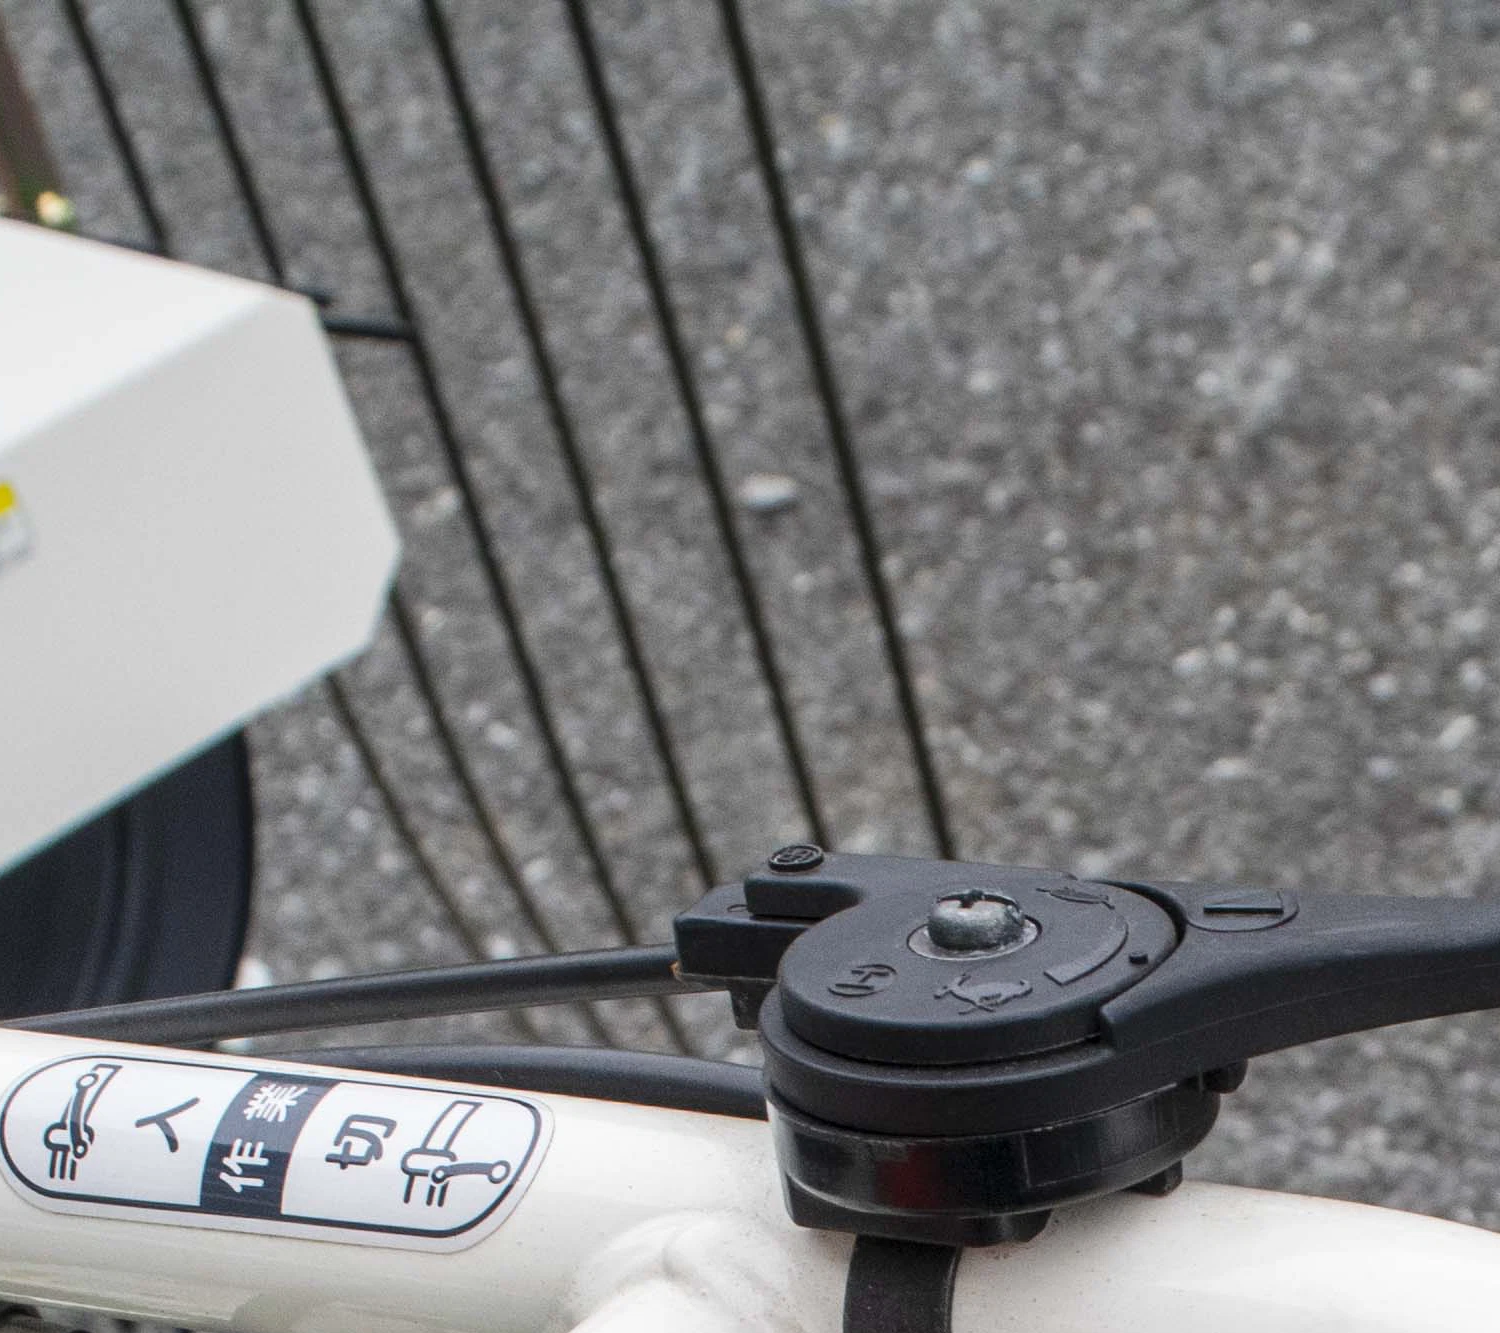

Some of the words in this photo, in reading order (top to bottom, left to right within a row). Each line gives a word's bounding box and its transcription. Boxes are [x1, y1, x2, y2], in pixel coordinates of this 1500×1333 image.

[134, 1097, 201, 1153] 入
[219, 1082, 308, 1193] 作業
[325, 1114, 397, 1170] 切
